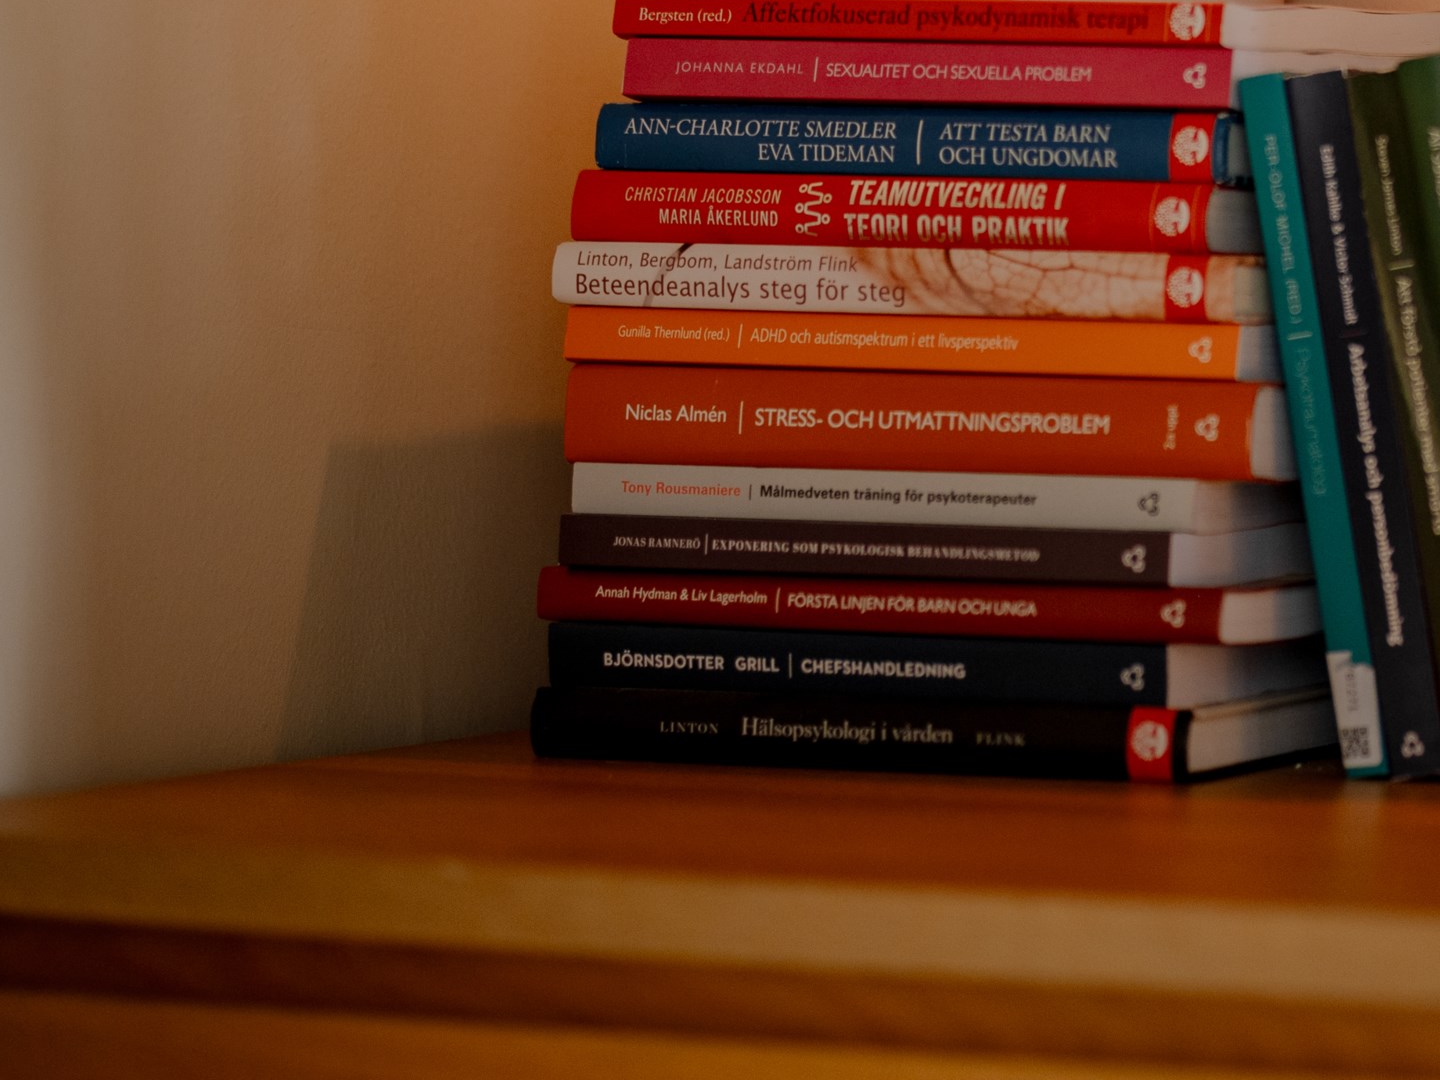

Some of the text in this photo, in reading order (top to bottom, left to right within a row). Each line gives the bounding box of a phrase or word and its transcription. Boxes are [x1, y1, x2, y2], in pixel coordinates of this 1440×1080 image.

[638, 6, 732, 24] Bergsten (red.)
[742, 1, 1149, 34] Affektfokuserad psykodynamisk terapi
[675, 61, 803, 74] JOHANNA EKDAHL
[826, 63, 1092, 82] SEXUALITET OCH SEXUELLA PROBLEM
[624, 117, 897, 140] ANN-CHARLOTTE SMEDLER
[939, 122, 1110, 144] ATT TESTA BARN
[758, 142, 895, 163] EVA TIDEMAN
[939, 145, 1118, 168] OCH UNGDOMAR
[624, 186, 782, 205] CHRISTIAN JACOBSSON
[848, 180, 1066, 209] TEAMUTVECKLING I
[658, 205, 778, 227] MARIA ÅKERLUND
[844, 213, 1070, 247] TEORI OCH PRAKTIK
[577, 251, 858, 272] Linton, Bergbom, Landström Flink
[575, 274, 906, 307] Beteendeanalys steg för steg
[618, 325, 730, 343] Gunilla Thernlund (red.)
[750, 329, 1018, 353] ADHD och autismspektrum i ett livsperspektiv
[625, 405, 727, 423] Niclas Almén
[755, 408, 1110, 435] STRESS- OCH UTMATTNINGSPROBLEM
[622, 480, 741, 497] Tony Rousmaniere
[759, 484, 1037, 507] Målmedveten träning för psykoterapeuter
[1347, 341, 1404, 647] Arbetsanalys och personbedömning
[613, 536, 701, 550] JONAS RAMNERÖ
[712, 540, 1040, 563] EXPONERING SOM PSYKOLOGISK BEHANDLINGSMETOD
[595, 585, 767, 607] Annah Hydman & Liv Lagerholm
[788, 592, 1036, 617] FÖRSTA LINJEN FÖR BARN OCH UNGA
[603, 649, 780, 673] BJÖRNSDOTTER GRILL
[801, 658, 965, 680] CHEFSHANDLEDNING
[659, 721, 719, 734] LINTON
[741, 716, 953, 744] Hälsopsykologi i vården
[977, 731, 1025, 746] FLINK
